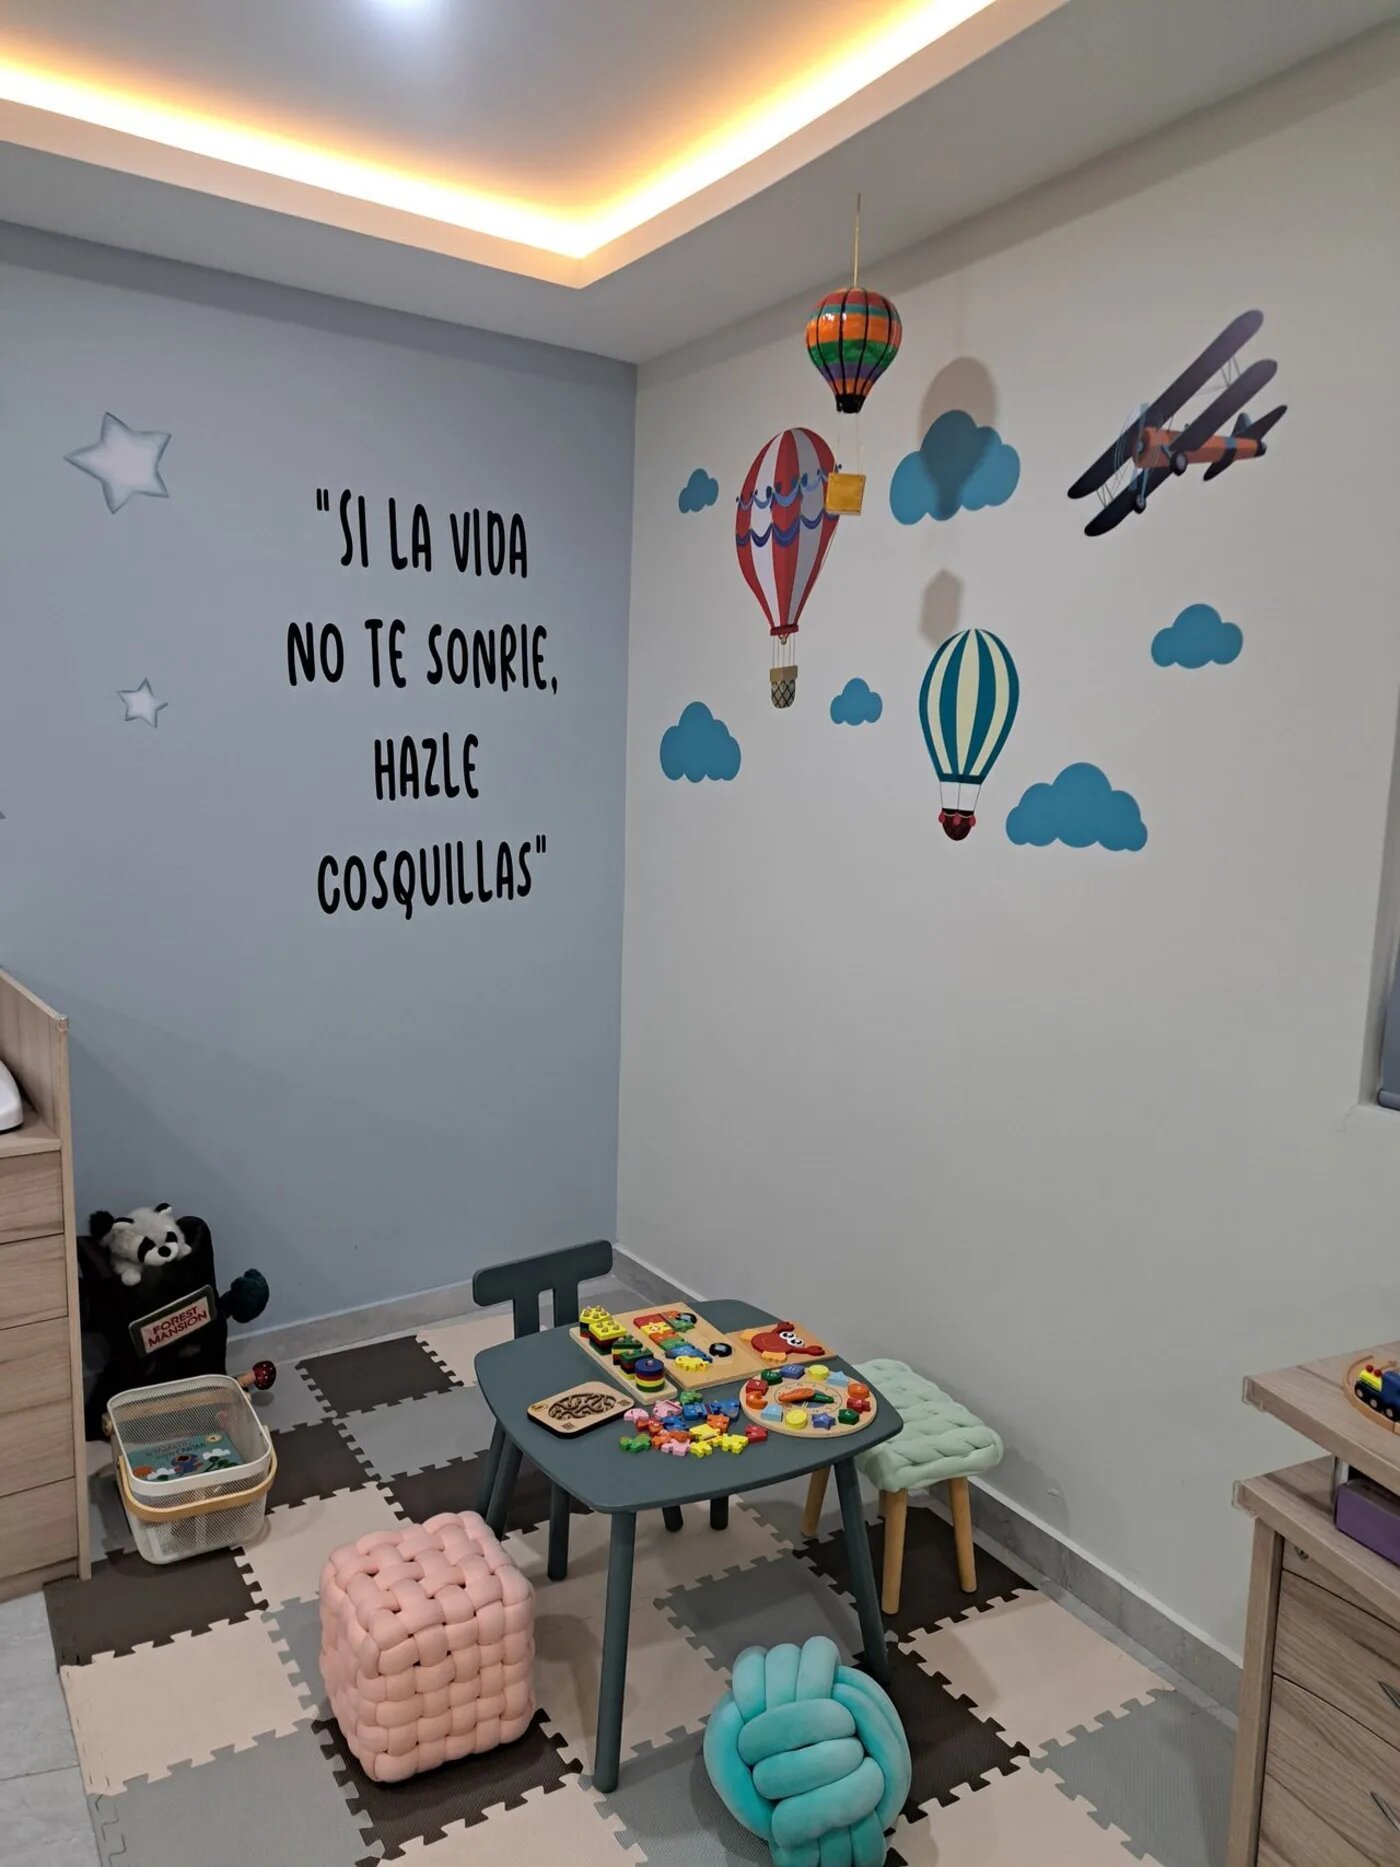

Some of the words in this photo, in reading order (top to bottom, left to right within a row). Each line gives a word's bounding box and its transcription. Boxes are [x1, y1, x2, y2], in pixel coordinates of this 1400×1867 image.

[316, 488, 369, 568] "SI
[388, 497, 432, 573] LA
[449, 507, 528, 579] VIDA
[287, 621, 345, 687] NO
[364, 618, 407, 689] TE
[426, 623, 558, 695] SONRIE,
[374, 731, 479, 802] HAZLE
[317, 834, 547, 921] COSQUILLAS"
[148, 1311, 207, 1346] MANSION
[153, 1306, 197, 1334] FOREST
